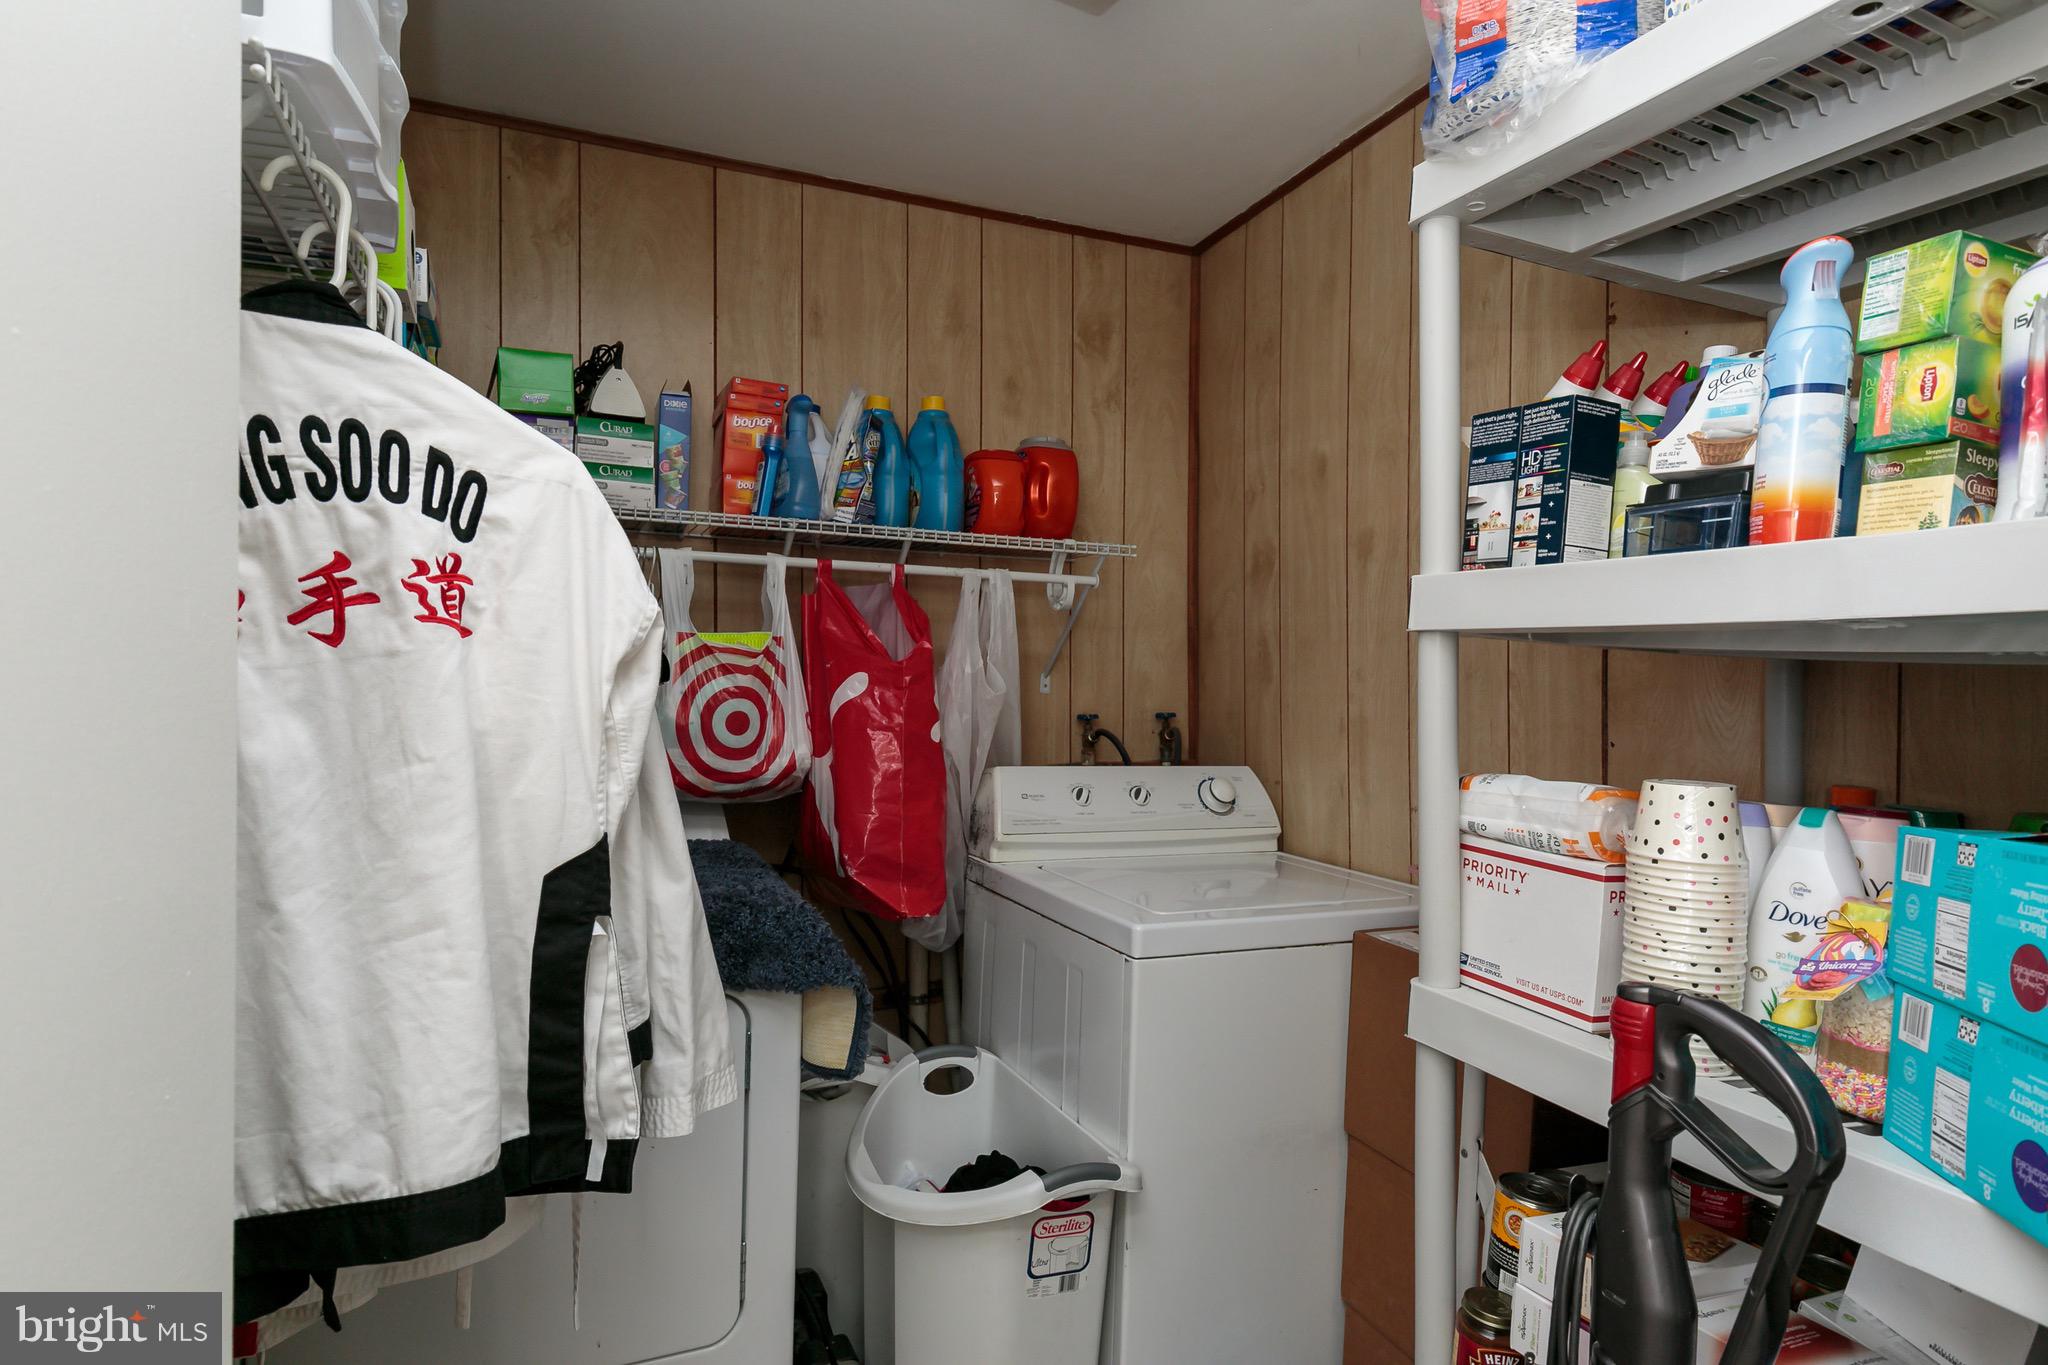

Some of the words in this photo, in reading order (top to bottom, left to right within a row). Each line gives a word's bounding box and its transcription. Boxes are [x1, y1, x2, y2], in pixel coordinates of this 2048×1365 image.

[1708, 363, 1758, 401] glade
[1923, 369, 1936, 400] Lipton
[600, 421, 633, 434] CURAD
[733, 416, 772, 428] bounce
[1473, 417, 1484, 425] Light
[1952, 421, 1968, 434] 20
[599, 465, 632, 477] CURAD
[1521, 465, 1540, 475] LIGHT
[299, 414, 411, 505] SOO
[421, 445, 488, 543] DO
[1463, 857, 1527, 884] PRIORITY
[1476, 876, 1509, 894] MAIL
[1768, 900, 1828, 930] Dove
[1468, 962, 1484, 972] POSTAL
[1470, 955, 1485, 965] UNITED
[1485, 960, 1501, 970] STATES
[1819, 961, 1857, 970] Unicorn
[1516, 977, 1530, 988] VISIT
[1531, 983, 1540, 992] US
[1540, 986, 1549, 995] AT
[1040, 1218, 1085, 1235] Sterilite
